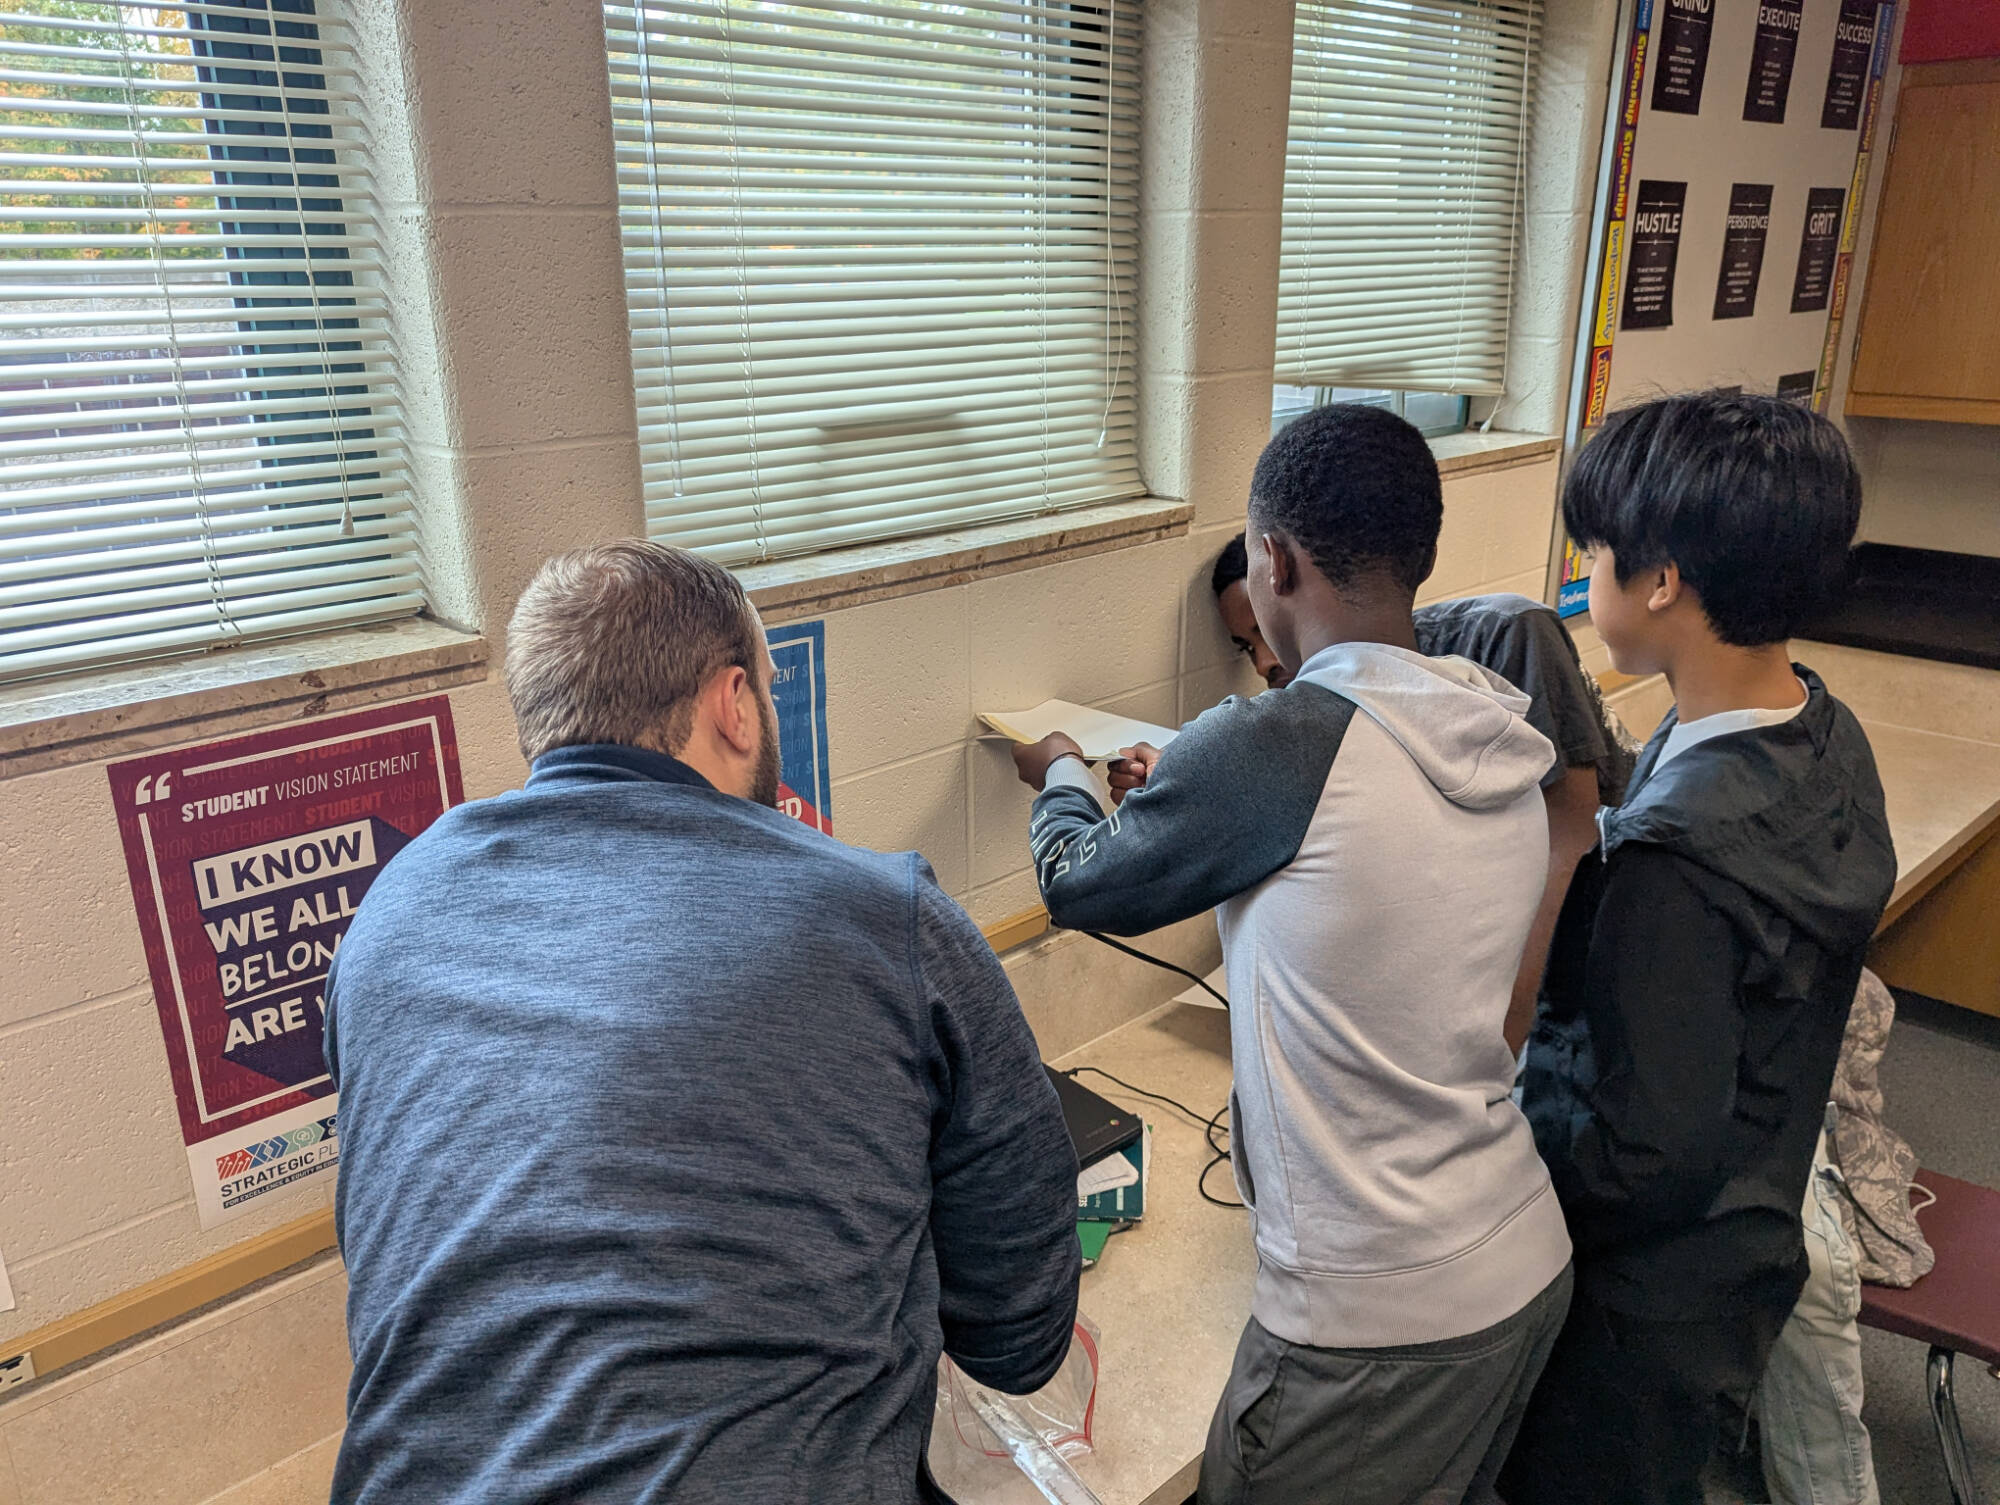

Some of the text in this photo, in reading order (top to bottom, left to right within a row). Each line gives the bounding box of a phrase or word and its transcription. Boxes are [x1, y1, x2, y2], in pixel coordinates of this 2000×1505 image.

[1758, 6, 1801, 31] EXECUTE
[1837, 21, 1873, 45] SUCCESS
[1624, 33, 1647, 126] Citizenship
[1613, 130, 1634, 218] Citizenship
[1635, 212, 1681, 234] HUSTLE
[1727, 214, 1769, 230] PERSISTENCE
[1809, 212, 1836, 235] GRIT
[180, 785, 270, 823] STUDENT
[275, 772, 329, 801] VISION
[333, 752, 420, 788] STATEMENT
[205, 867, 220, 900] I
[231, 830, 362, 892] KNOW
[204, 906, 279, 954] WE
[288, 886, 359, 933] ALL
[224, 997, 307, 1053] ARE
[220, 1143, 338, 1198] STRATEGIC PL
